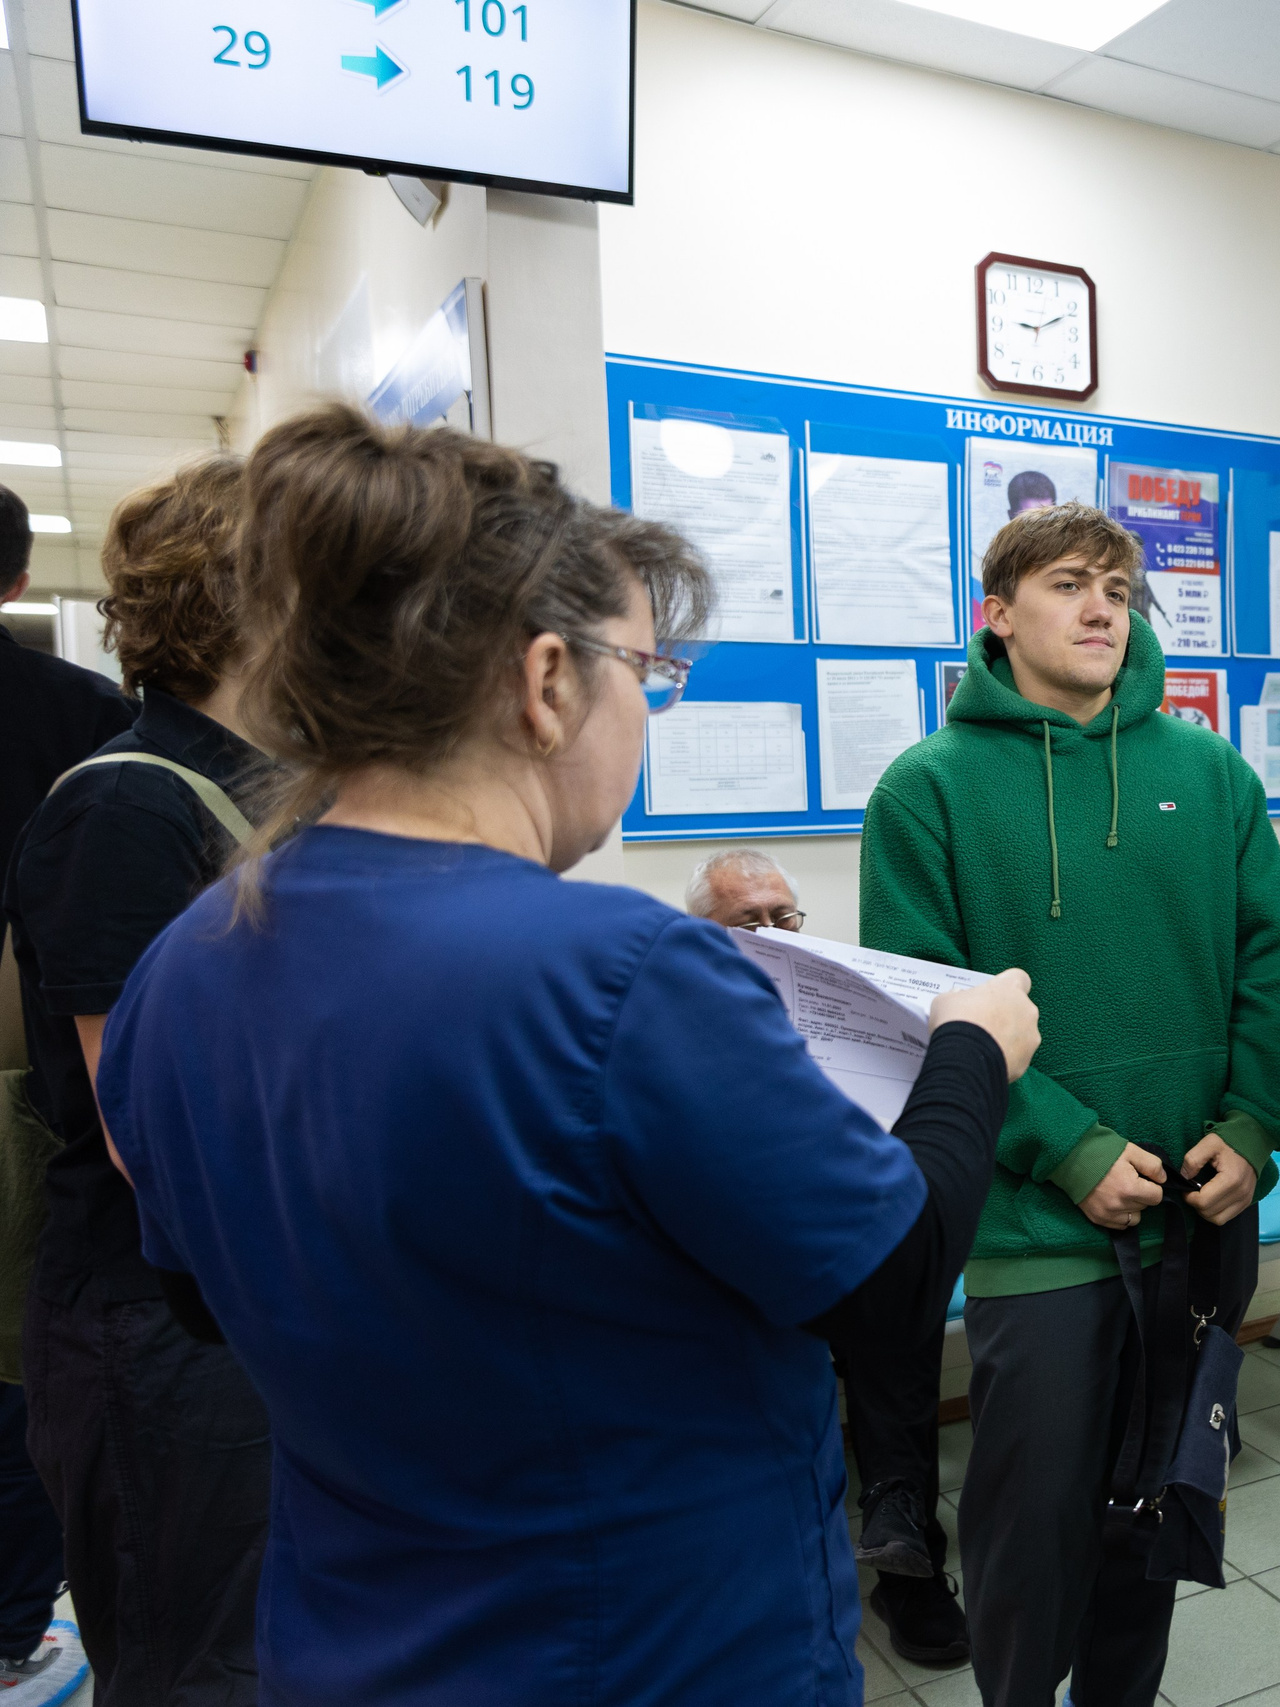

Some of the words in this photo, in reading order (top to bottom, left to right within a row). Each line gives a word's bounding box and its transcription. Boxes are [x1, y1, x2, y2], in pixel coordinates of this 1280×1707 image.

[455, 0, 529, 42] 101
[212, 25, 271, 70] 29
[456, 65, 536, 111] 119
[1006, 273, 1017, 291] 11
[1026, 276, 1044, 295] 12
[1053, 281, 1060, 298] 1
[1067, 301, 1078, 318] 2
[991, 315, 1004, 333] 9
[1068, 327, 1079, 344] 3
[993, 343, 1005, 360] 8
[1011, 360, 1021, 379] 7
[1069, 353, 1081, 370] 4
[1032, 365, 1044, 382] 6
[1053, 368, 1065, 384] 5
[945, 408, 1114, 447] ИНФОРМАЦИЯ
[1128, 474, 1202, 509] ПОБЕДУ
